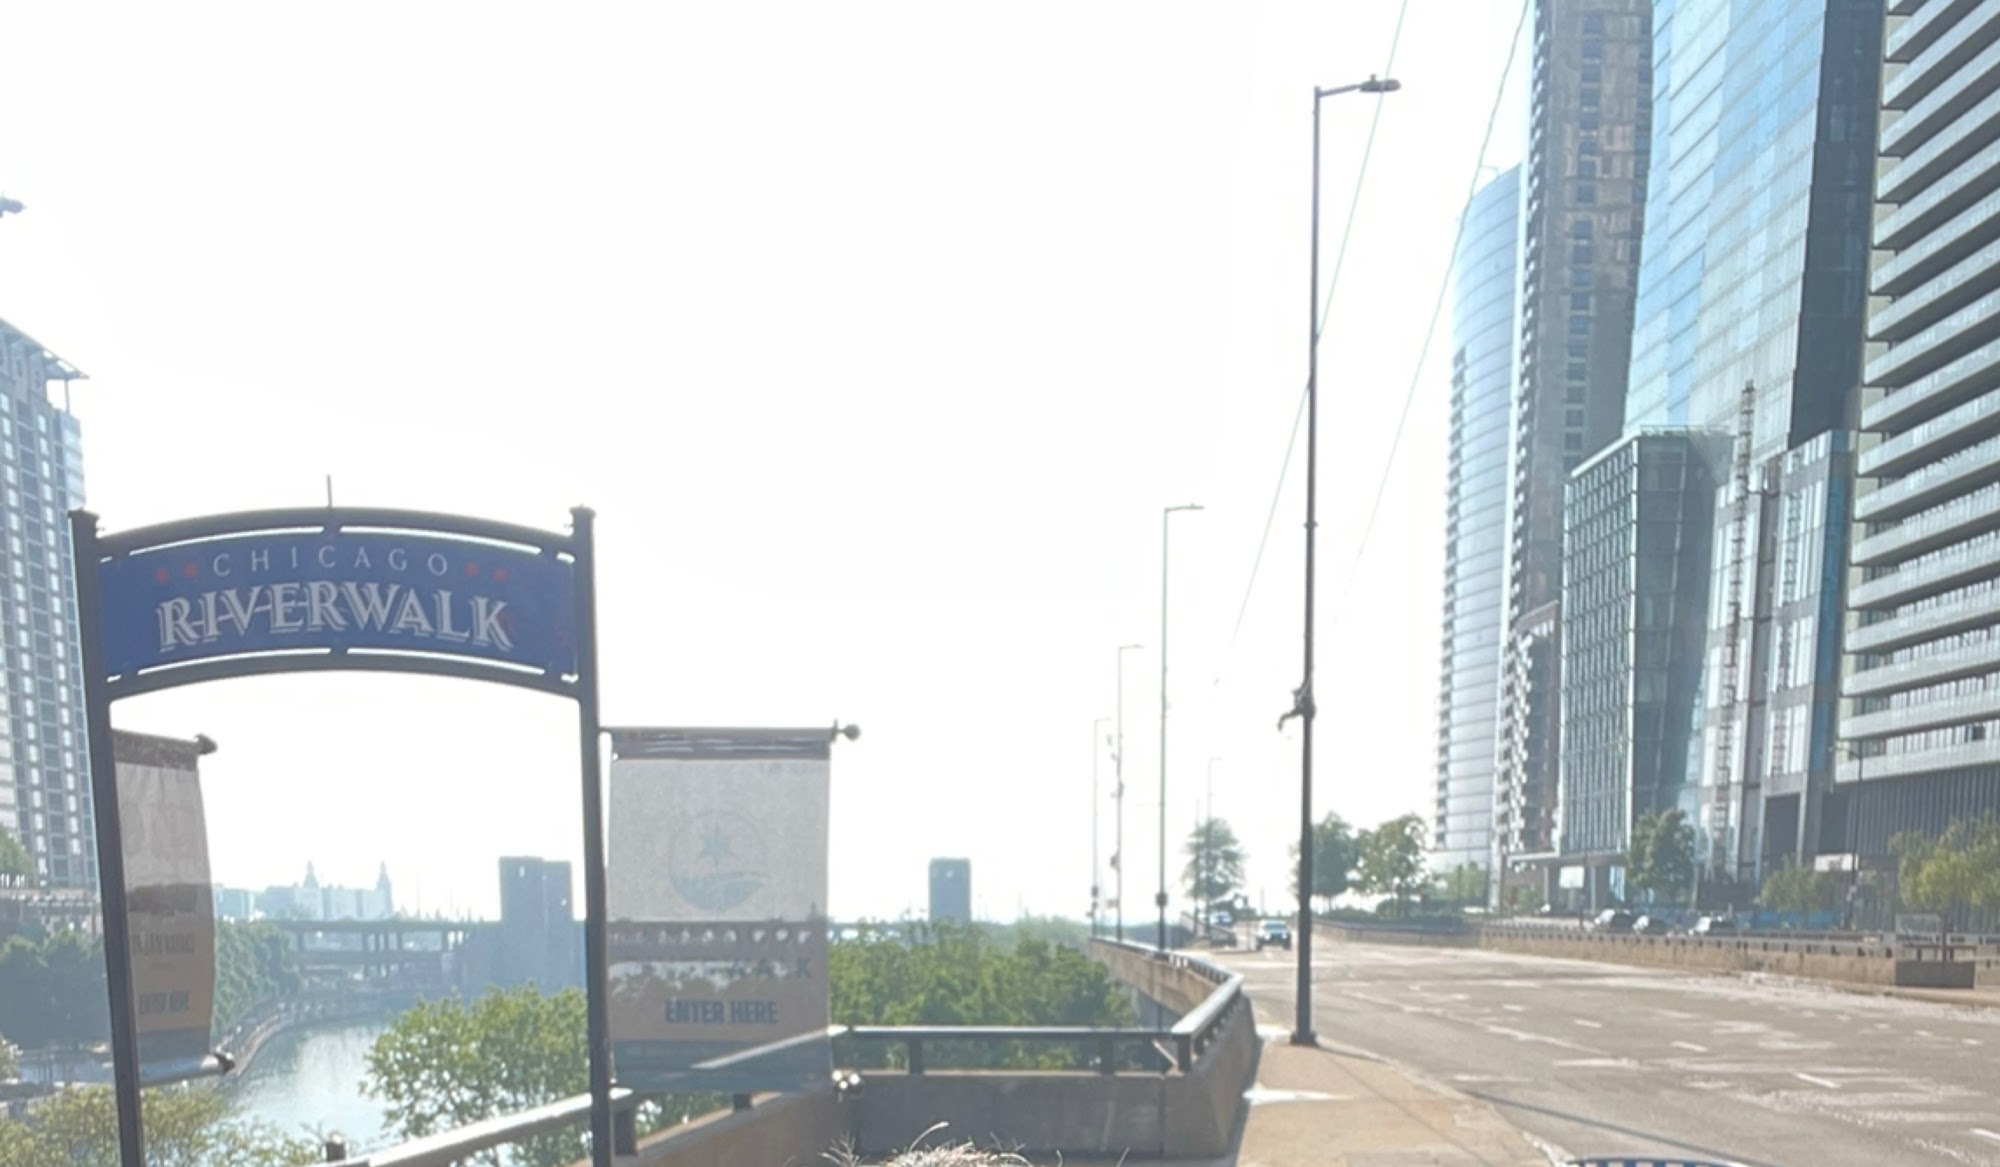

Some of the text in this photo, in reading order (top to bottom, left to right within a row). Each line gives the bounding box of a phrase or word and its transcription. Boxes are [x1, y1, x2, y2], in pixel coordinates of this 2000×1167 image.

[213, 545, 448, 577] CHICAGO
[155, 579, 514, 653] RIVERWALK
[665, 1000, 778, 1024] ENTER HERE
